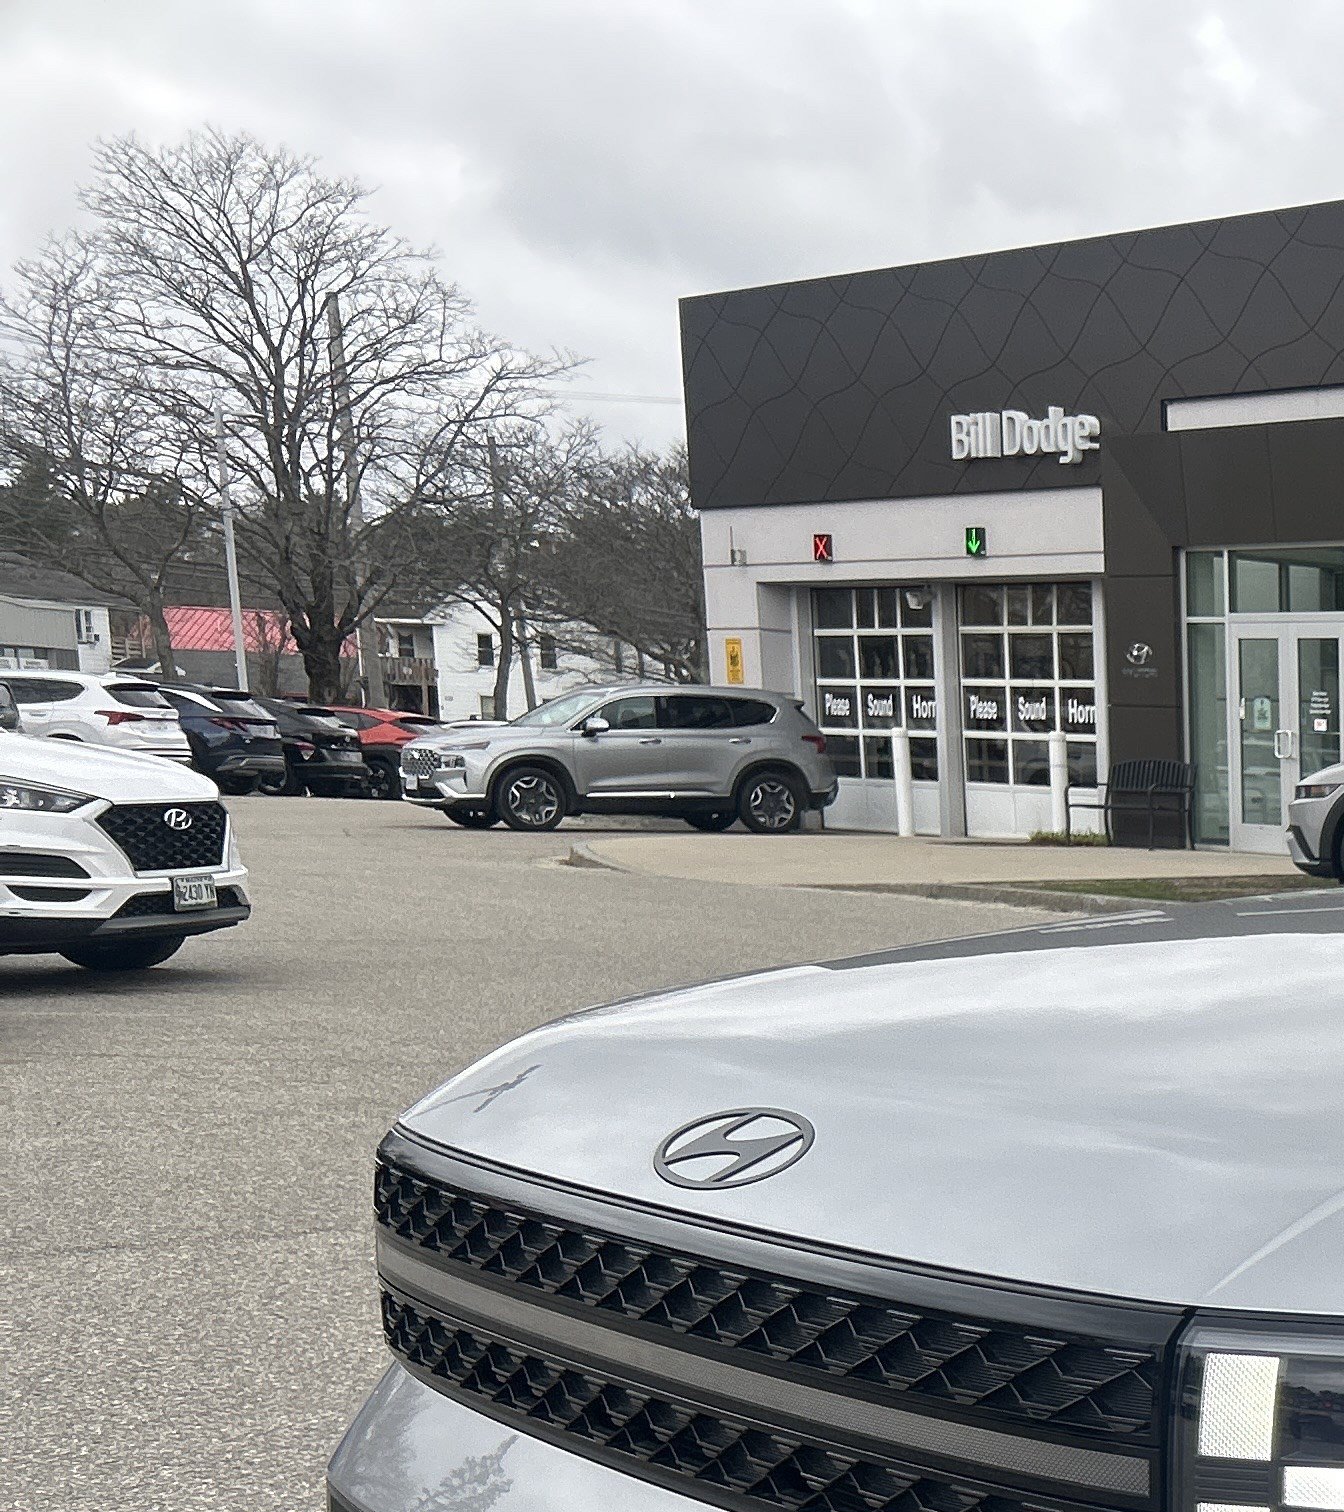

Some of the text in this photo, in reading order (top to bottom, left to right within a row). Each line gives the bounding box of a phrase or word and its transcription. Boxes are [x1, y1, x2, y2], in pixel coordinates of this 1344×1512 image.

[951, 405, 1100, 464] Bill Dodge
[825, 692, 850, 716] Please
[867, 693, 894, 717] Sound
[969, 694, 1097, 724] Please Sound Horn
